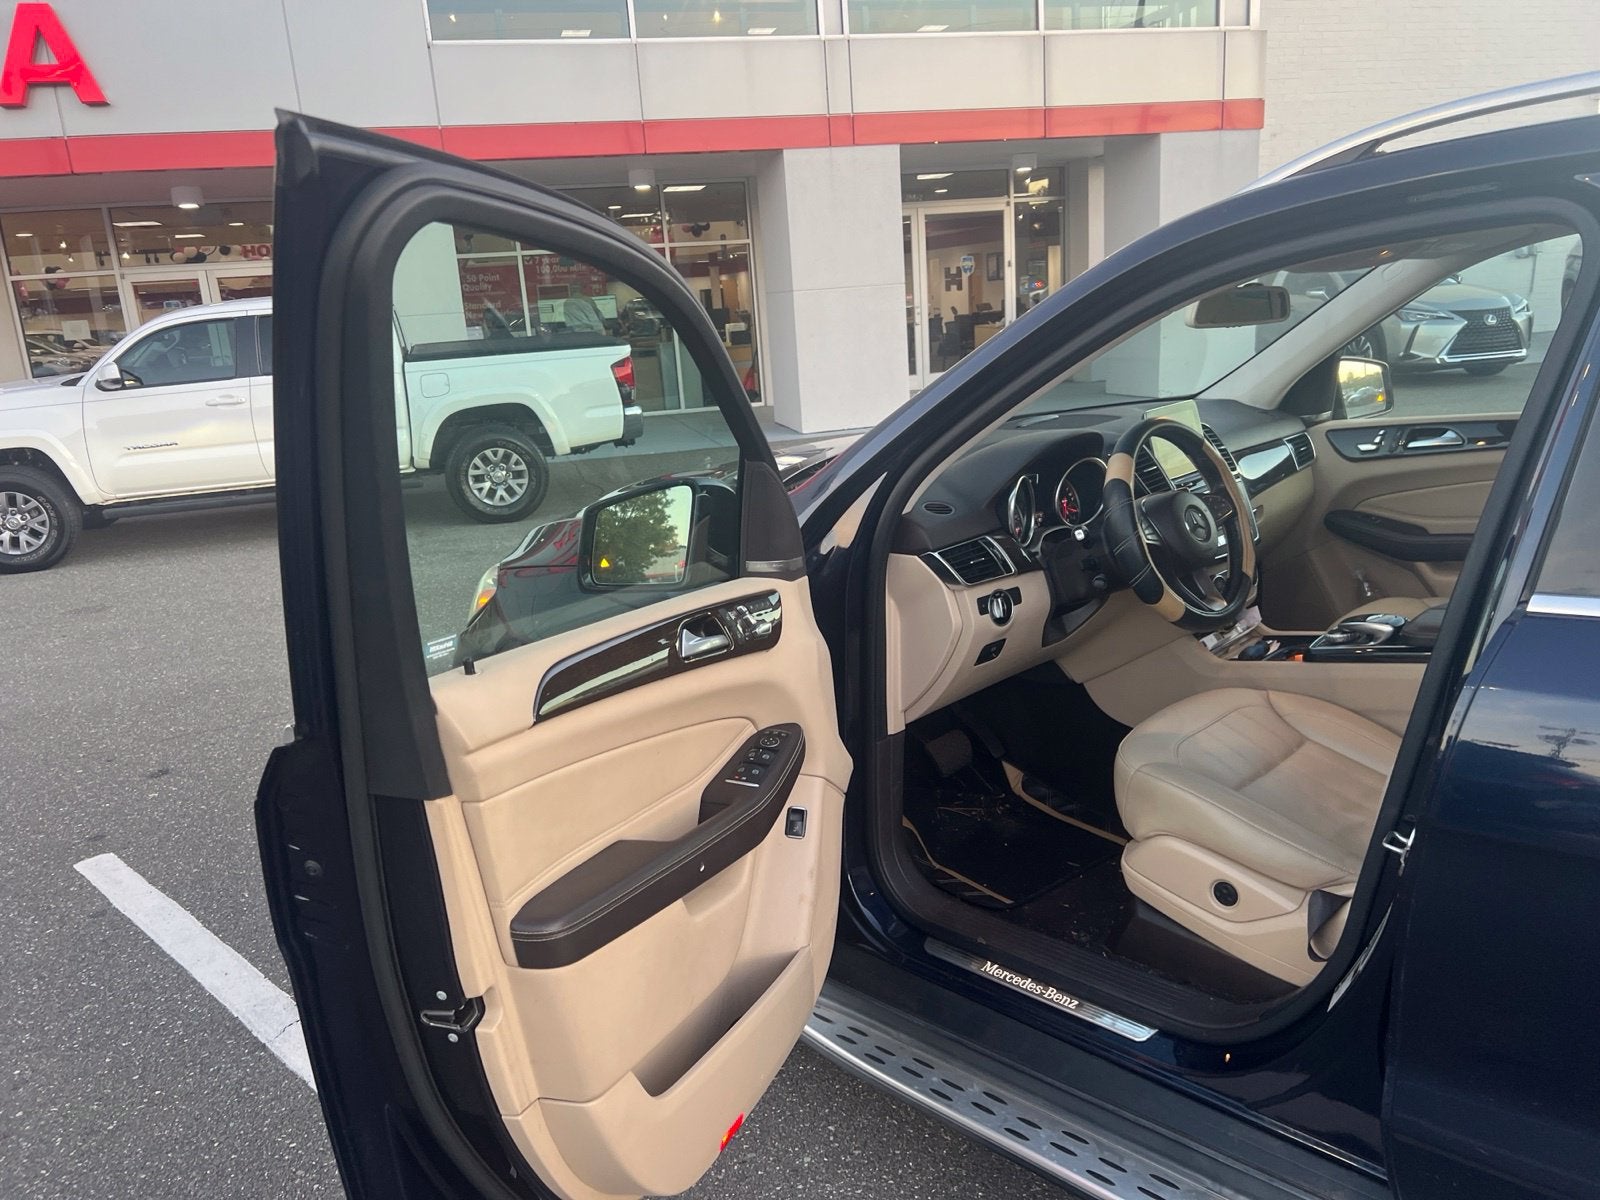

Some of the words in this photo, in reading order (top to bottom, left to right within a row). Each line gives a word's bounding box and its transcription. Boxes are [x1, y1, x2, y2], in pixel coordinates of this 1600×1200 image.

[0, 3, 110, 108] A
[240, 244, 272, 258] HO
[478, 273, 500, 282] Point
[463, 282, 493, 292] Quality
[981, 960, 1080, 1010] Mercedes-Benz
